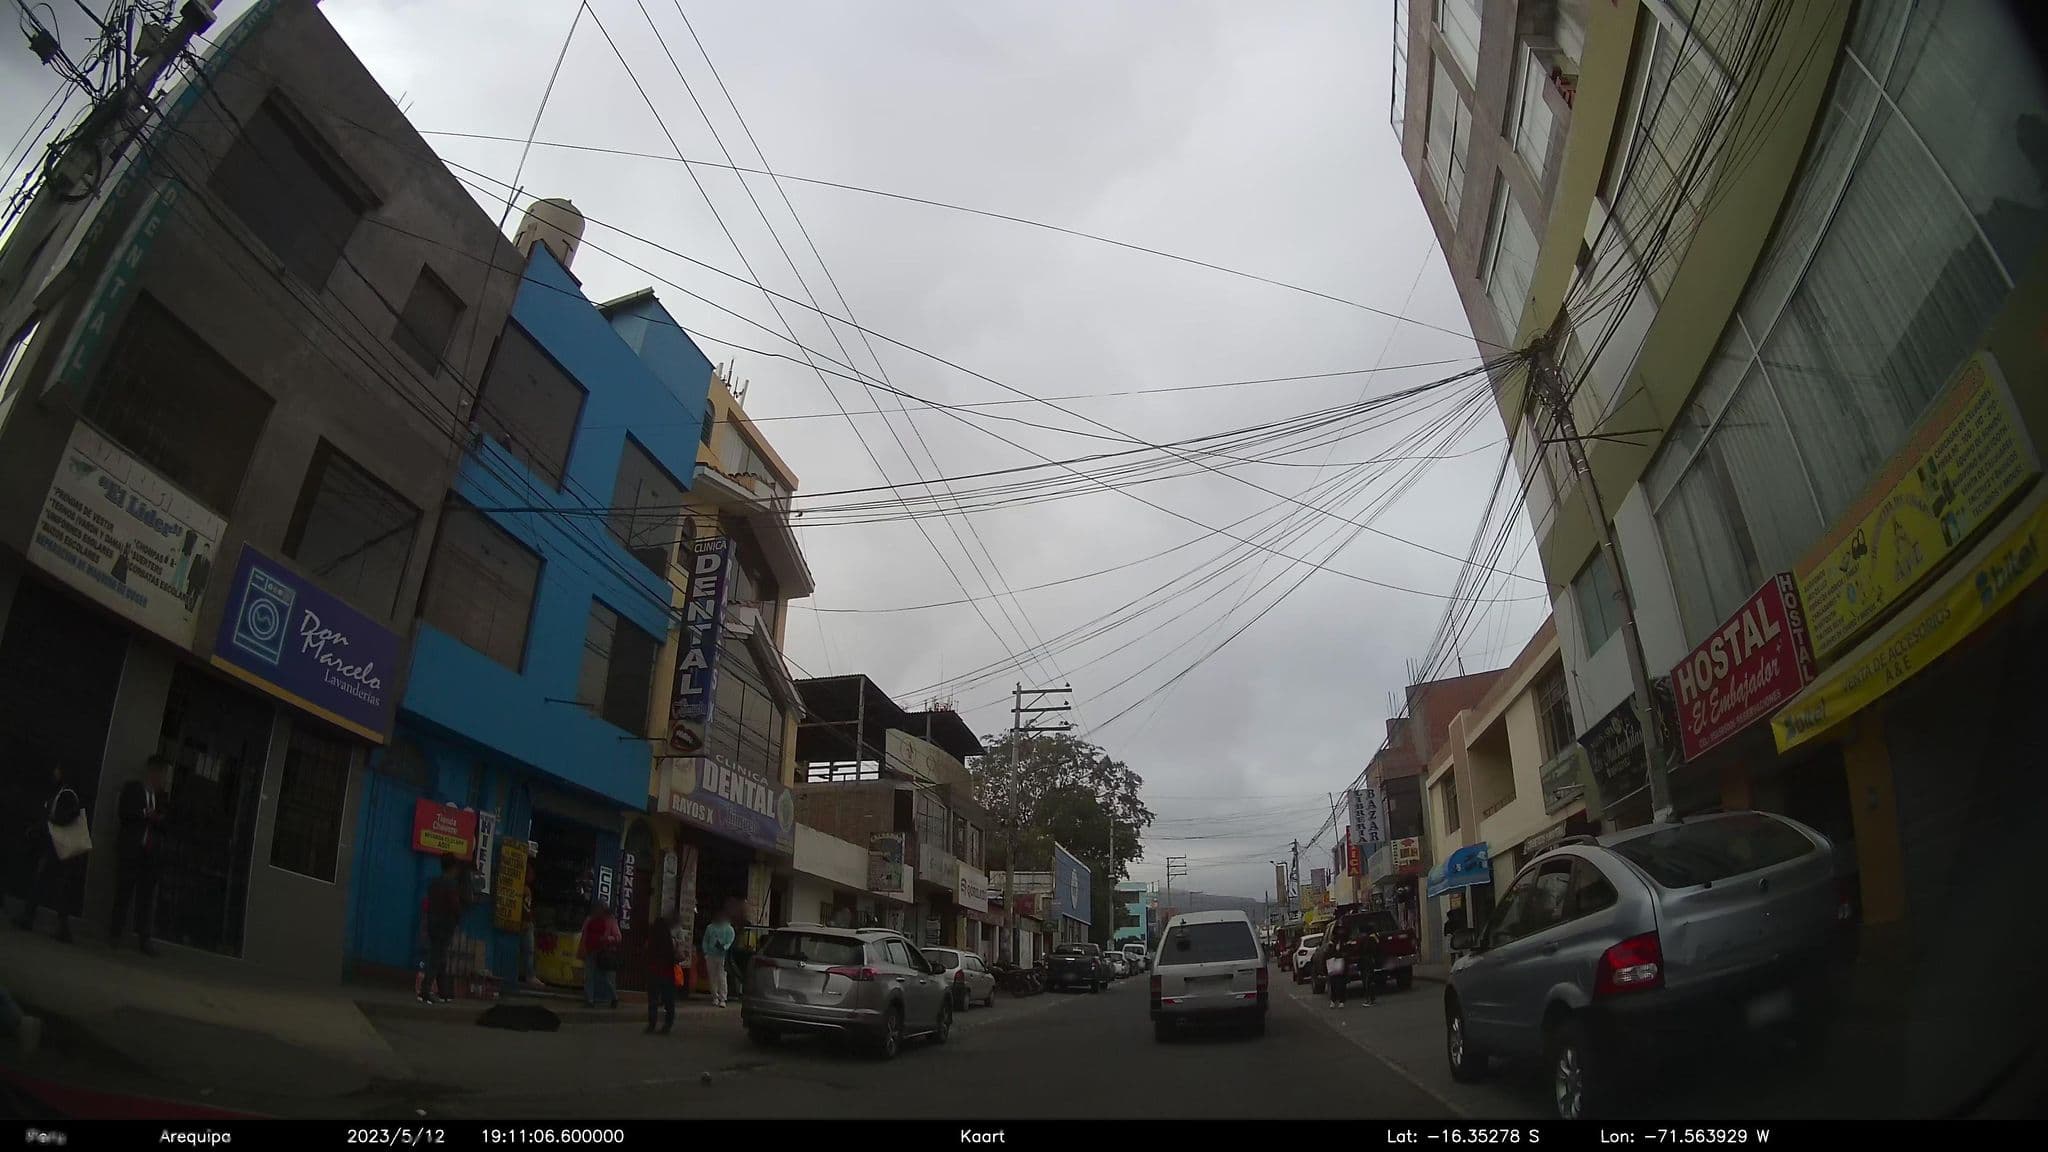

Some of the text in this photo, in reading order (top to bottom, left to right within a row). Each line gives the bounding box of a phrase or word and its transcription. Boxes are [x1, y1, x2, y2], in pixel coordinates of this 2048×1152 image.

[694, 541, 727, 553] CLINICA
[300, 609, 349, 646] Don
[680, 554, 722, 695] DENTAL
[1677, 596, 1781, 705] HOSTAL
[1778, 573, 1814, 683] HOSTAL
[301, 632, 381, 690] Marcelo
[1692, 701, 1708, 735] El
[1710, 656, 1781, 724] Embajador
[702, 757, 775, 819] DENTAL
[715, 754, 769, 786] CLINICA
[672, 794, 708, 820] RAYOS
[1367, 789, 1380, 841] BAZAR
[621, 852, 636, 916] DENTAL
